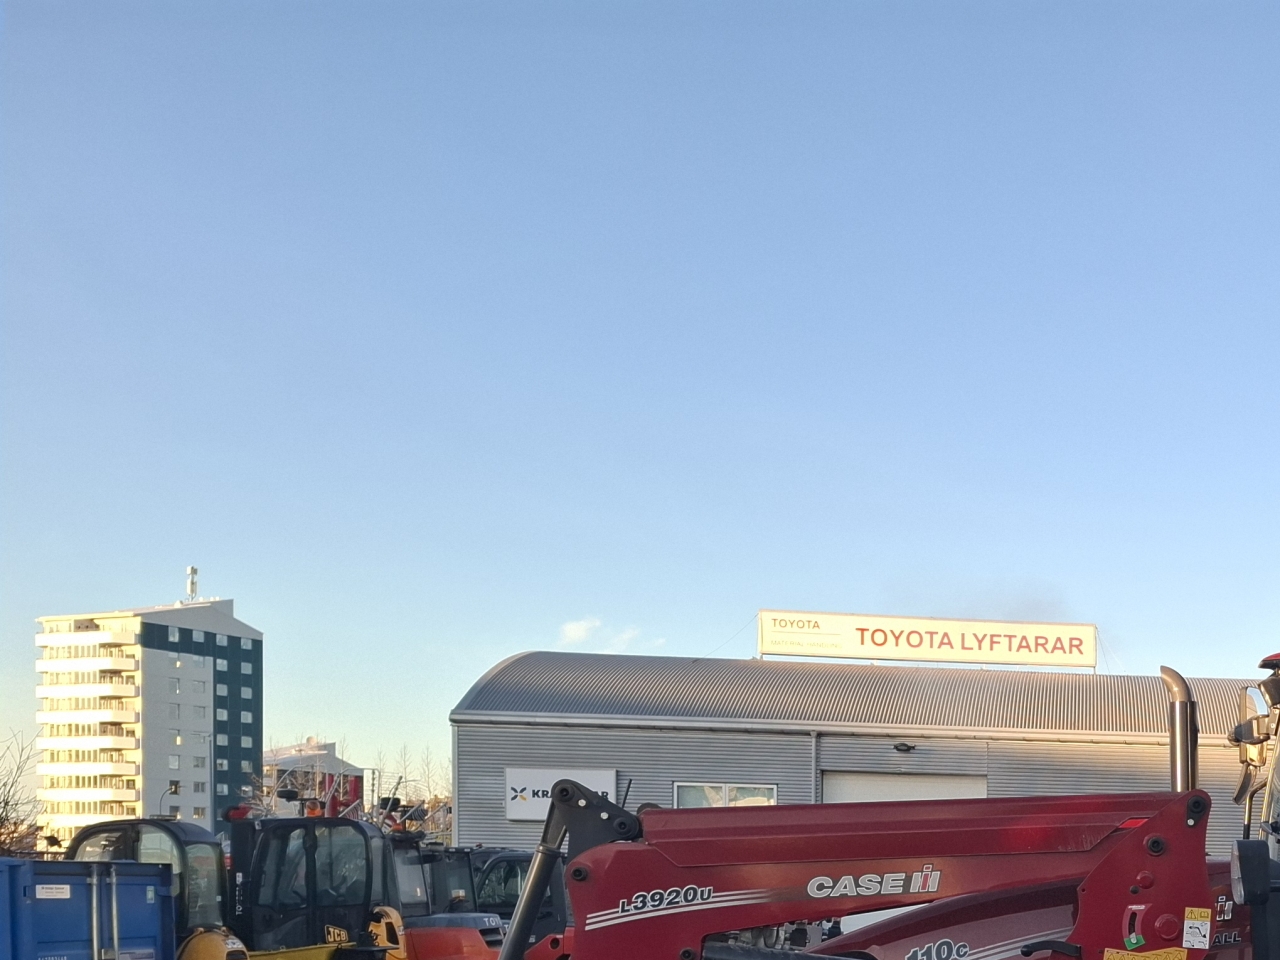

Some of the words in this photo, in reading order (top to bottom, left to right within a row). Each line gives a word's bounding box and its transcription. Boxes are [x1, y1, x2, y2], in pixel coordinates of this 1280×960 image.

[771, 618, 821, 630] TOYOTA
[855, 627, 954, 650] TOYOTA
[961, 632, 1085, 655] LYFTARAR
[807, 872, 906, 898] CASE
[326, 926, 348, 943] JCB
